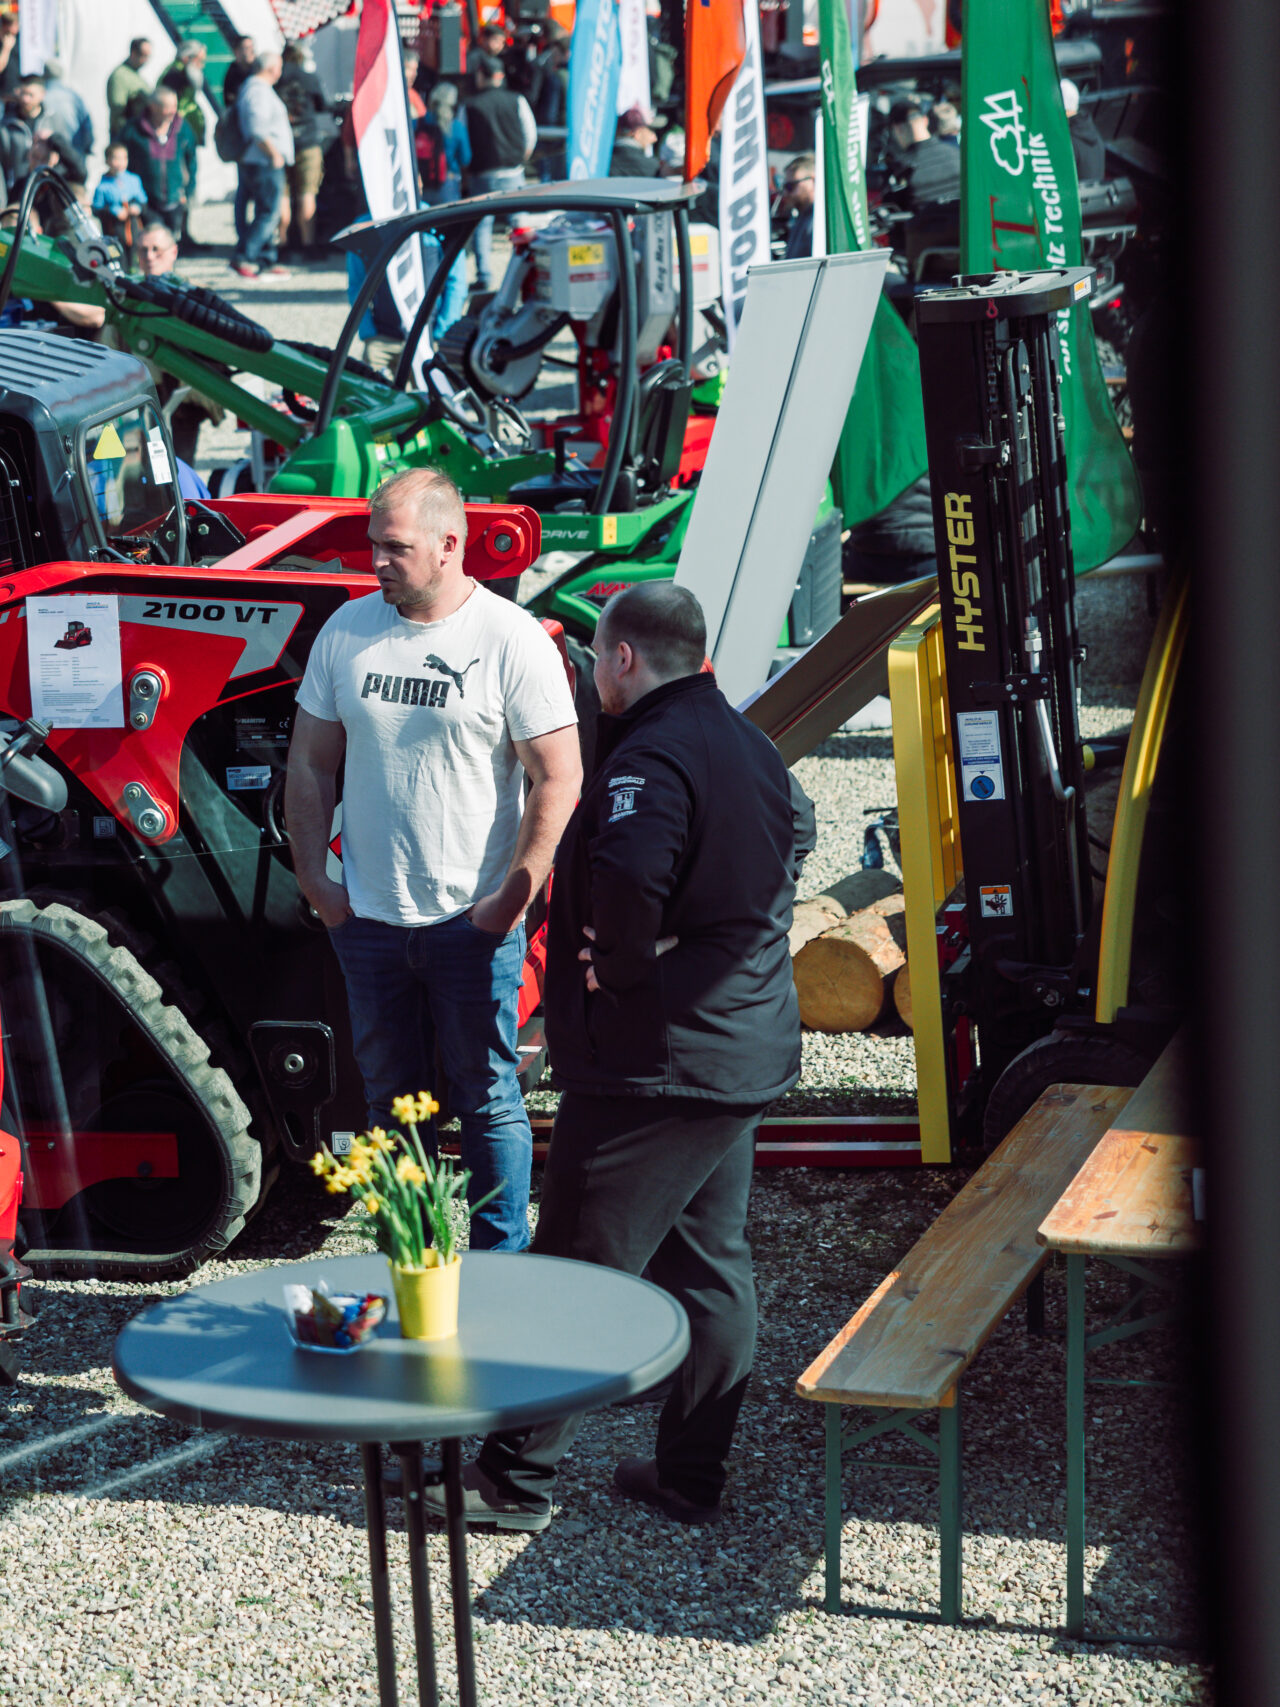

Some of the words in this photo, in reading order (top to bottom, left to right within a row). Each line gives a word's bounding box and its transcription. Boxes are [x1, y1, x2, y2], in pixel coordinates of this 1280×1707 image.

[1027, 131, 1065, 235] Technik
[944, 492, 986, 652] HYSTER
[142, 601, 225, 621] 2100
[234, 605, 278, 624] VT
[360, 672, 451, 709] PUMA
